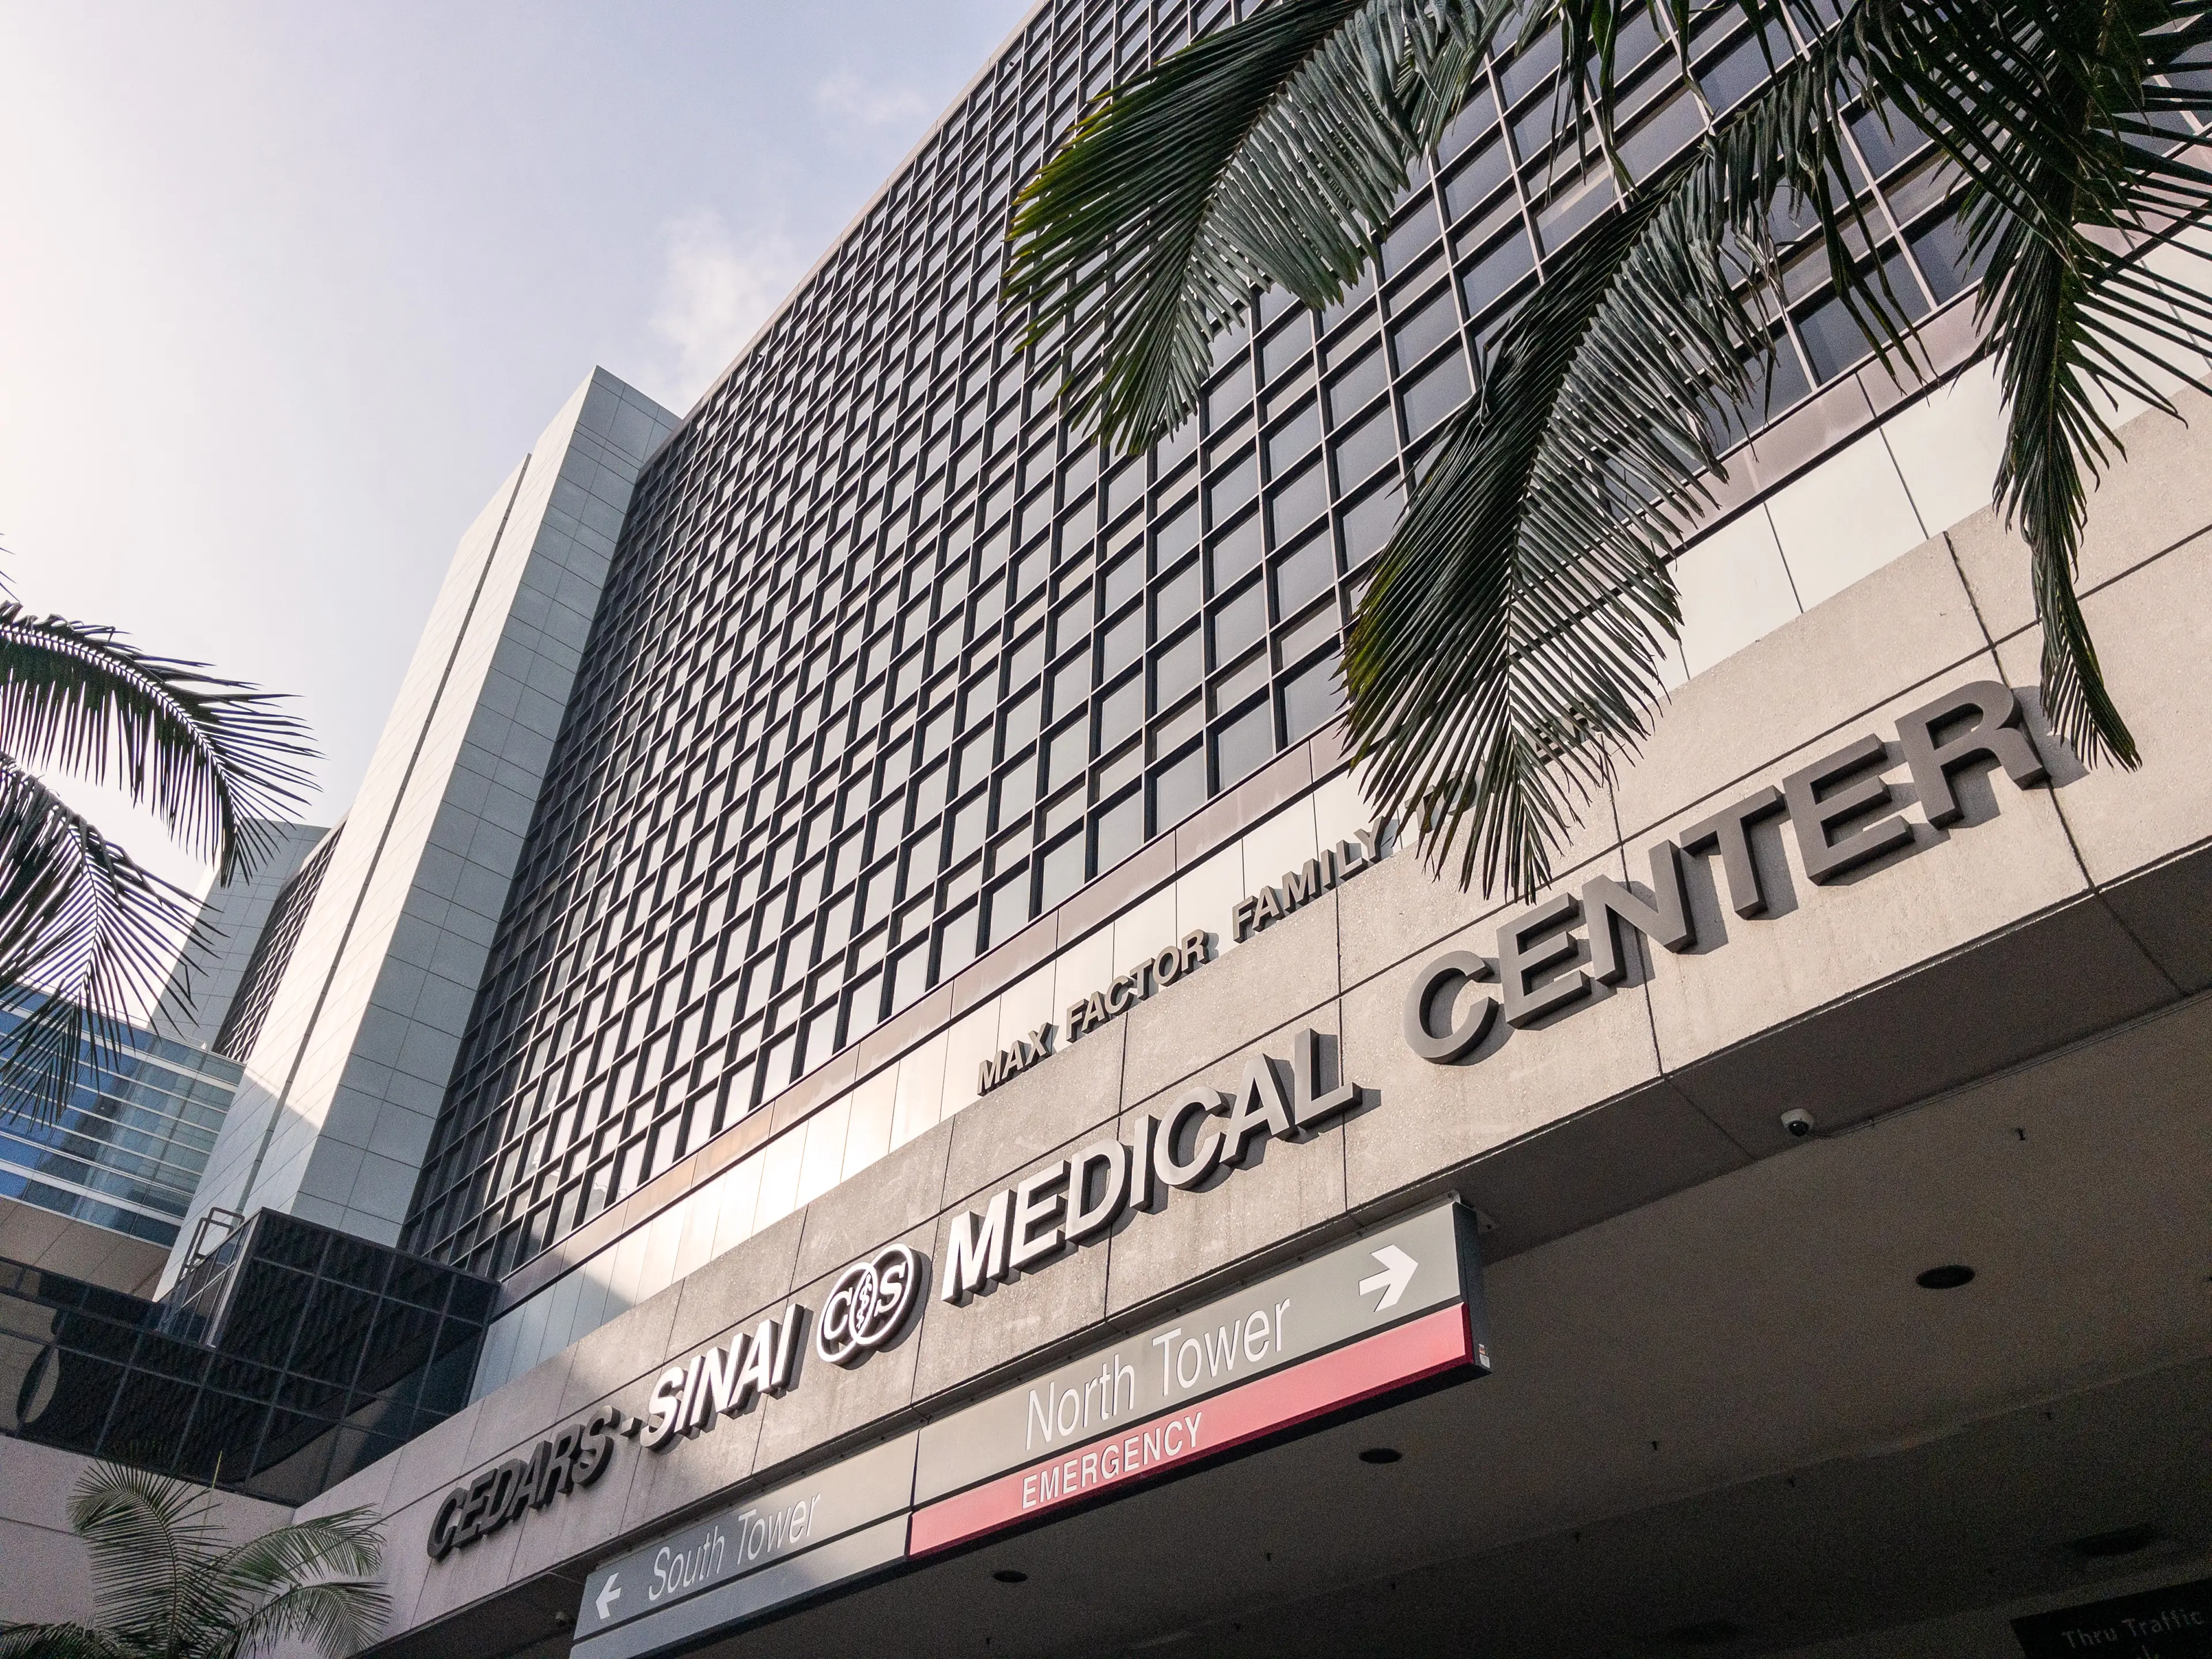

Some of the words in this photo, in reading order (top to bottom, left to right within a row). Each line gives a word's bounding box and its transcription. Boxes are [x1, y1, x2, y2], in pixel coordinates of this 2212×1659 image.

[941, 1028, 1362, 1303] MEDICAL
[1403, 680, 2051, 1063] CENTER
[977, 1022, 1053, 1096] MAX
[1066, 929, 1211, 1043] FACTOR
[1232, 816, 1387, 944] FAMILY
[1025, 1353, 1135, 1450] North
[1153, 1298, 1290, 1396] Tower
[1022, 1412, 1202, 1509] EMERGENCY
[649, 1525, 725, 1601] South
[737, 1492, 821, 1565] Tower
[2061, 1627, 2118, 1649] Thru
[2122, 1608, 2205, 1637] Traffic
